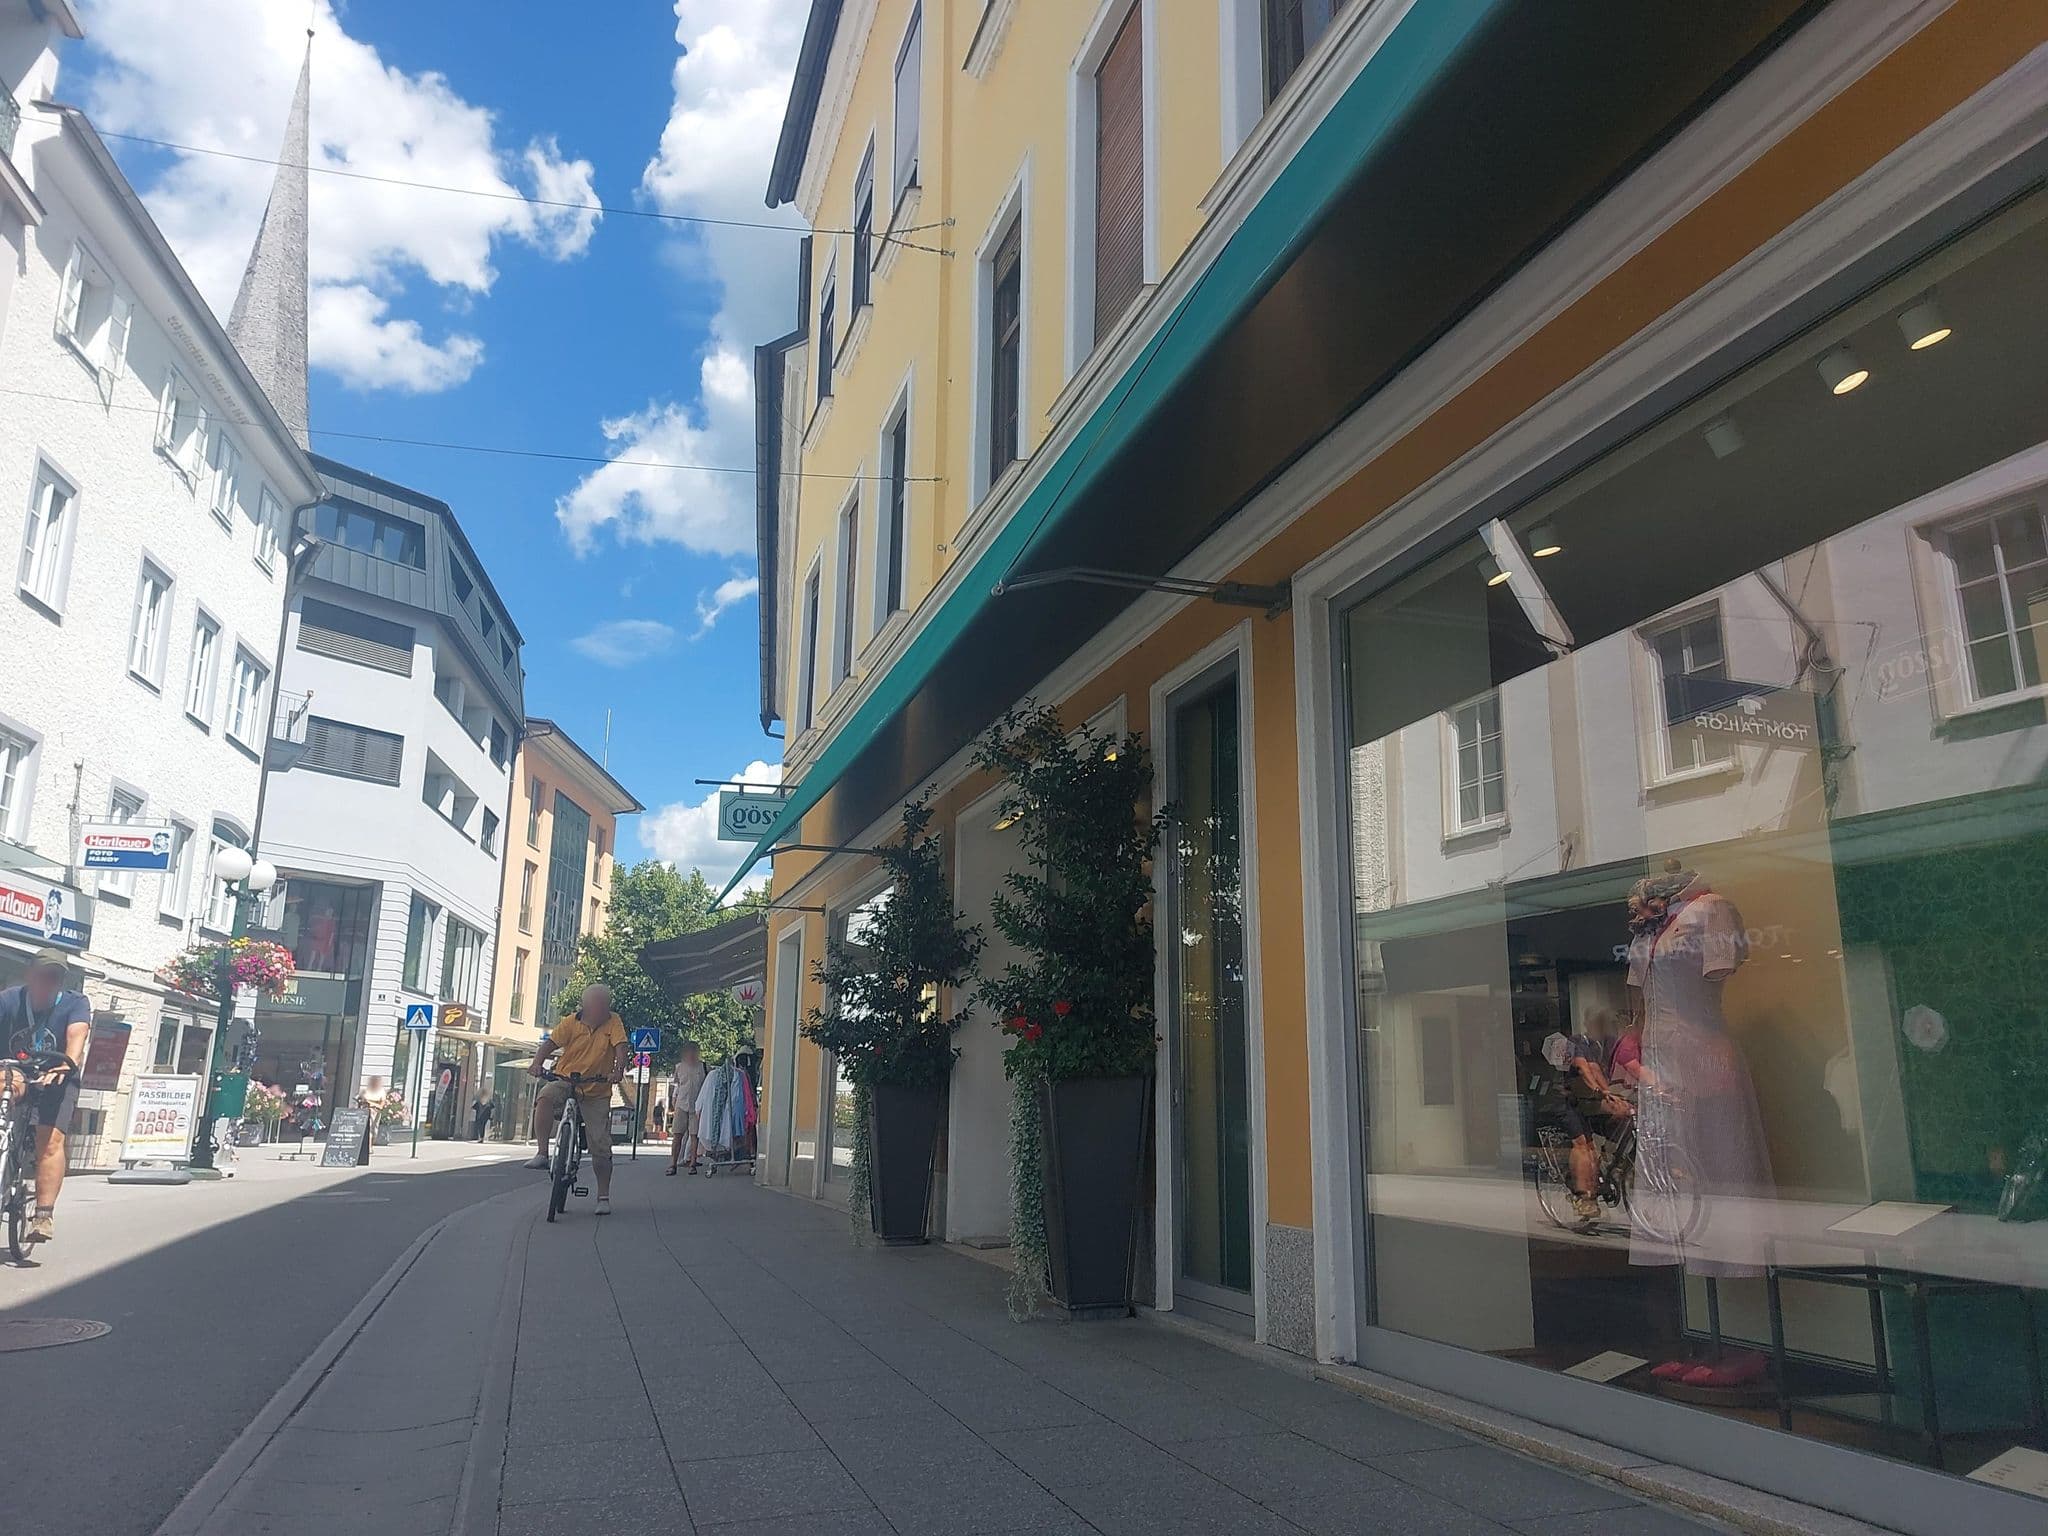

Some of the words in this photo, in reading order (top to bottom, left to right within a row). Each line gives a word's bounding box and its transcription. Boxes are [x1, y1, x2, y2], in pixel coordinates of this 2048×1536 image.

[88, 834, 149, 849] Hartlauer
[0, 892, 42, 921] rtlauer
[61, 927, 90, 941] HANDY
[270, 994, 307, 1006] POESIE
[138, 1091, 192, 1100] PASSBILDER
